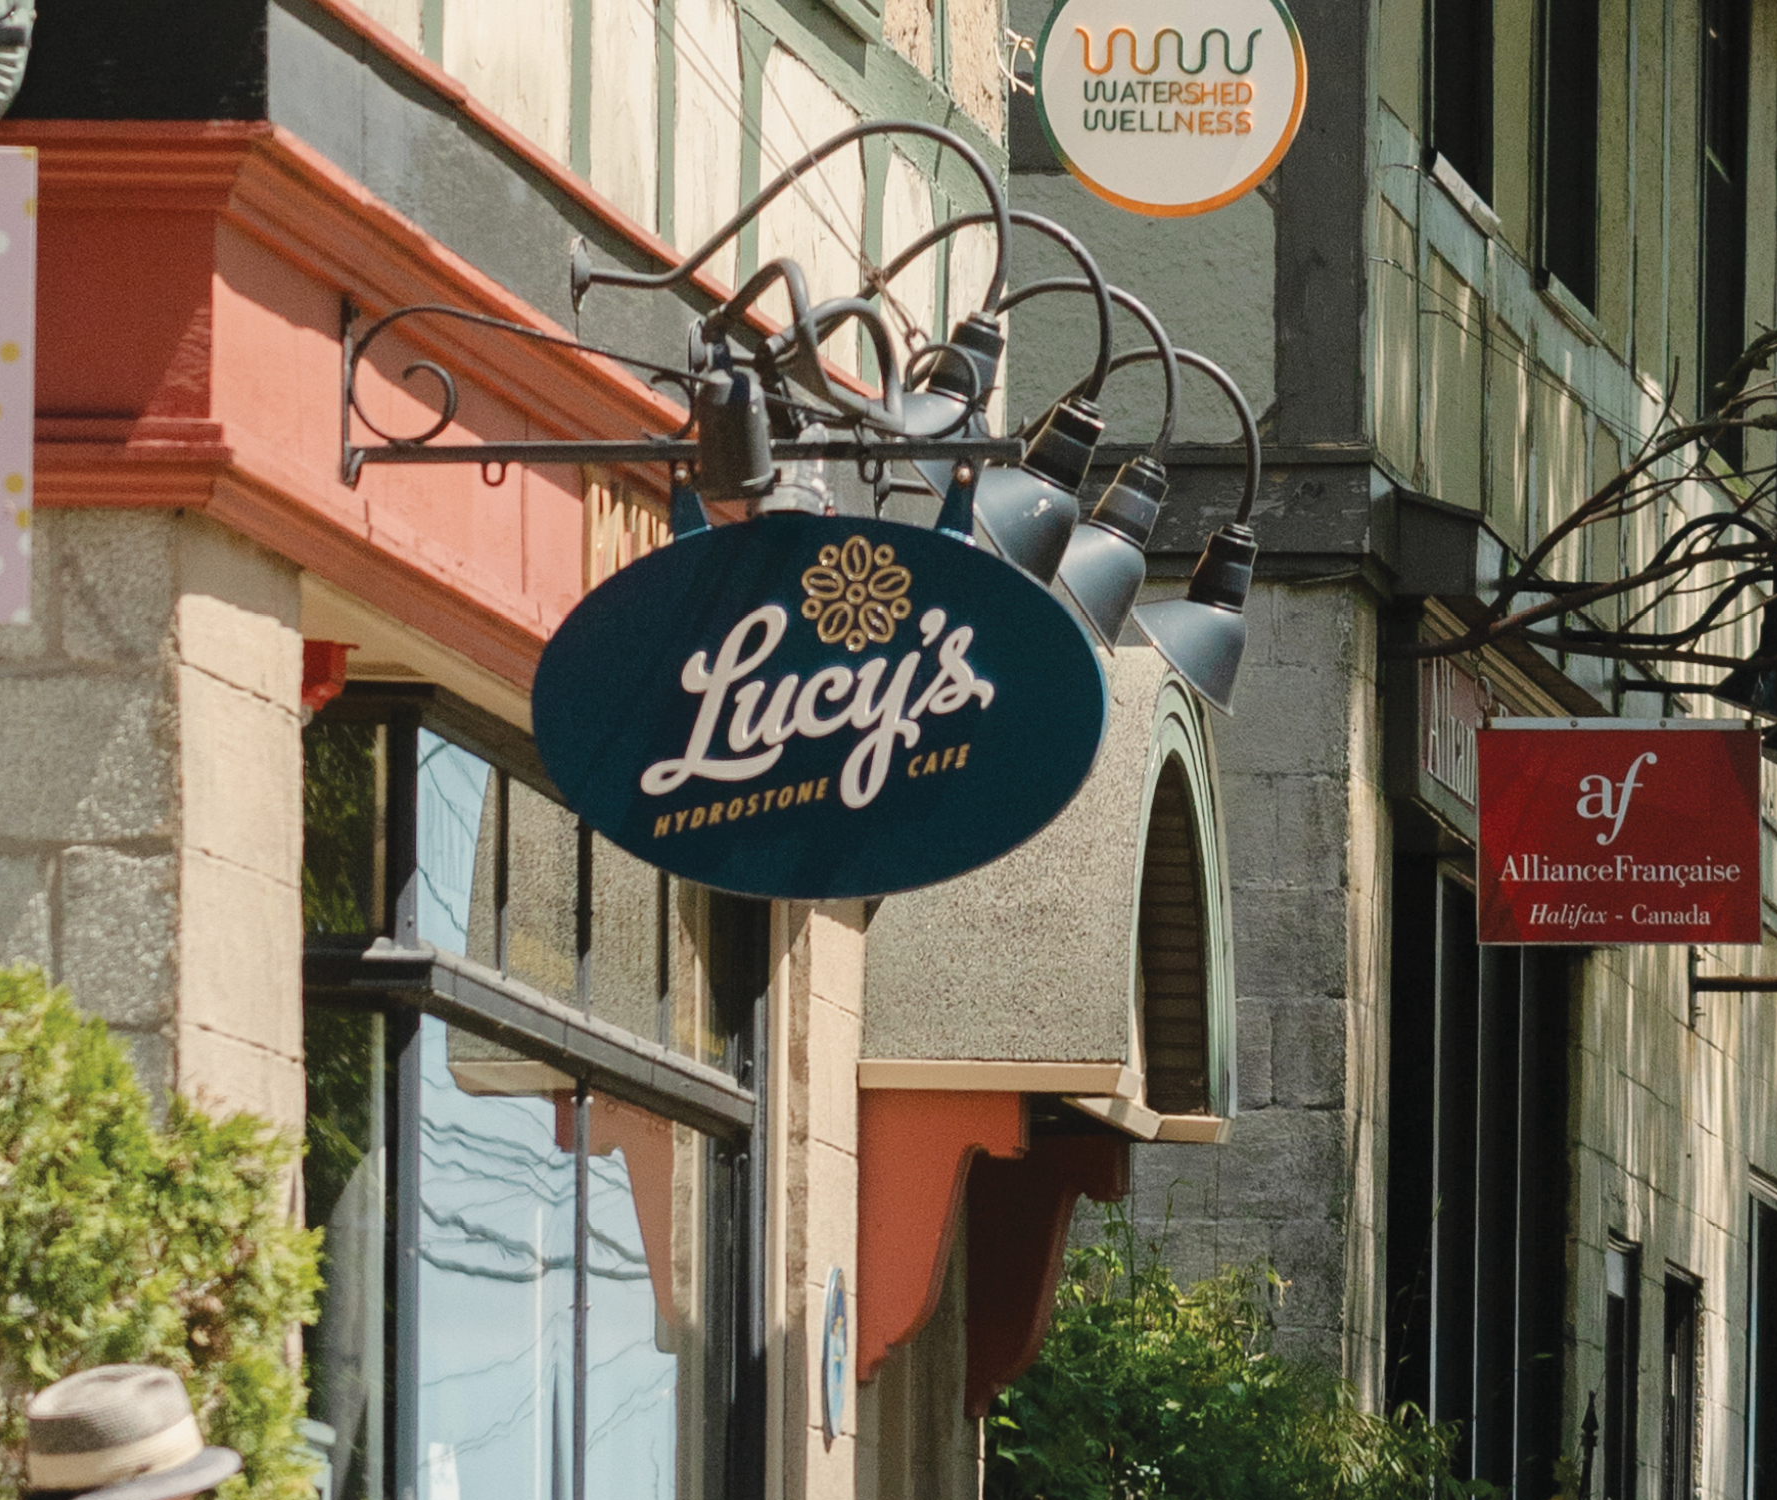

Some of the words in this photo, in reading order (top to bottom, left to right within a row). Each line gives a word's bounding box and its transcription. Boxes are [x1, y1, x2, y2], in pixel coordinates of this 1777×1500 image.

[1083, 80, 1253, 105] WATERSHED
[1083, 109, 1253, 135] WELLNESS
[640, 604, 995, 809] Lucy's
[653, 777, 829, 838] HYDROSTONE
[907, 743, 971, 778] CAFE
[1576, 751, 1658, 846] af
[1529, 904, 1607, 929] Halifax
[1631, 904, 1711, 925] Canada
